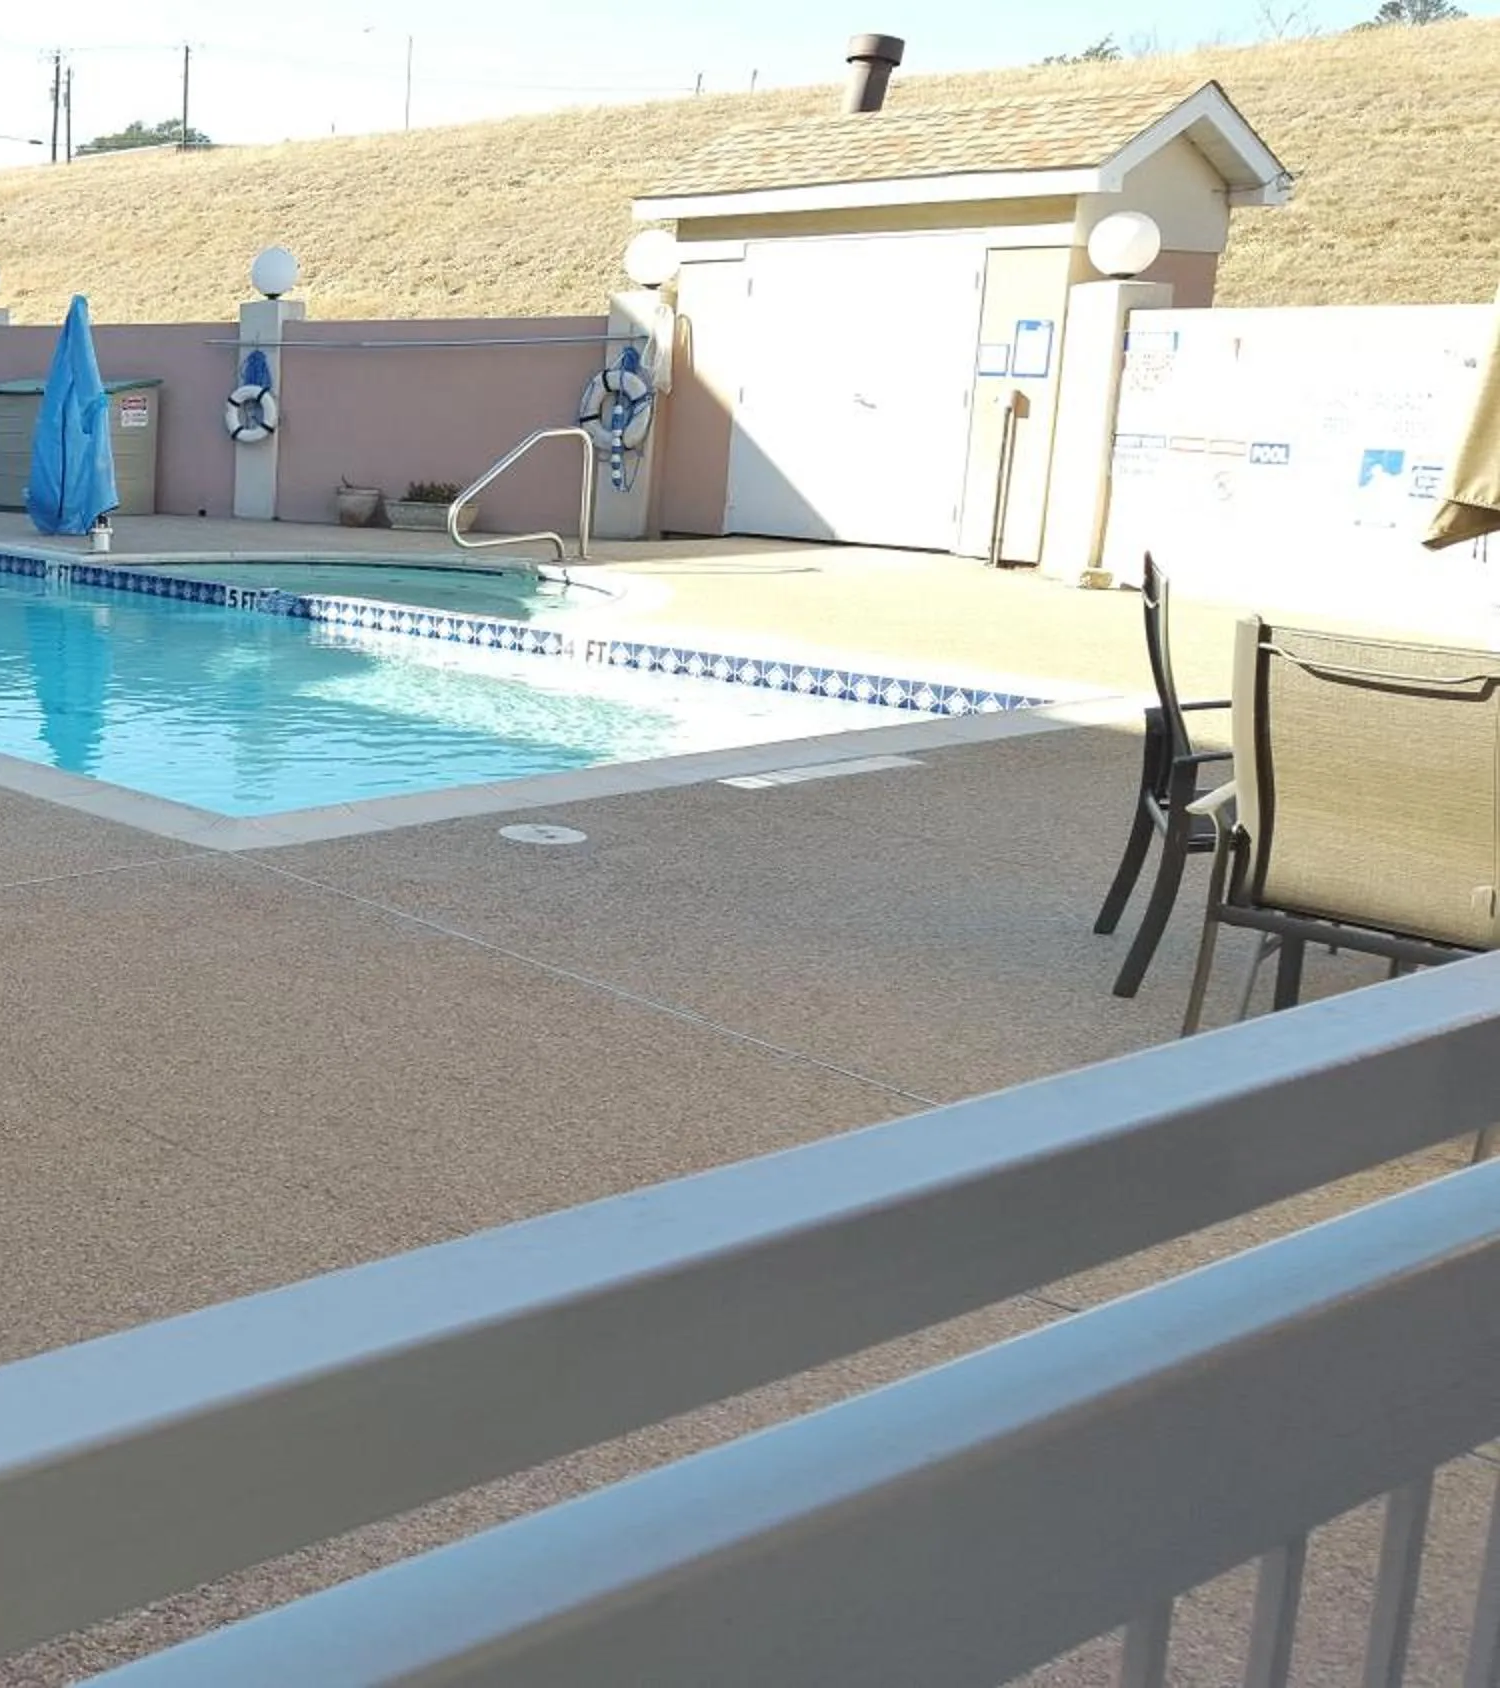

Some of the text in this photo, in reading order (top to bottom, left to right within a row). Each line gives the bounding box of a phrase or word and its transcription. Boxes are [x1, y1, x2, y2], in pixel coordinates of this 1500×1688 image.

[1252, 444, 1287, 463] POOL
[227, 589, 257, 611] 5 FT
[585, 639, 608, 664] FT
